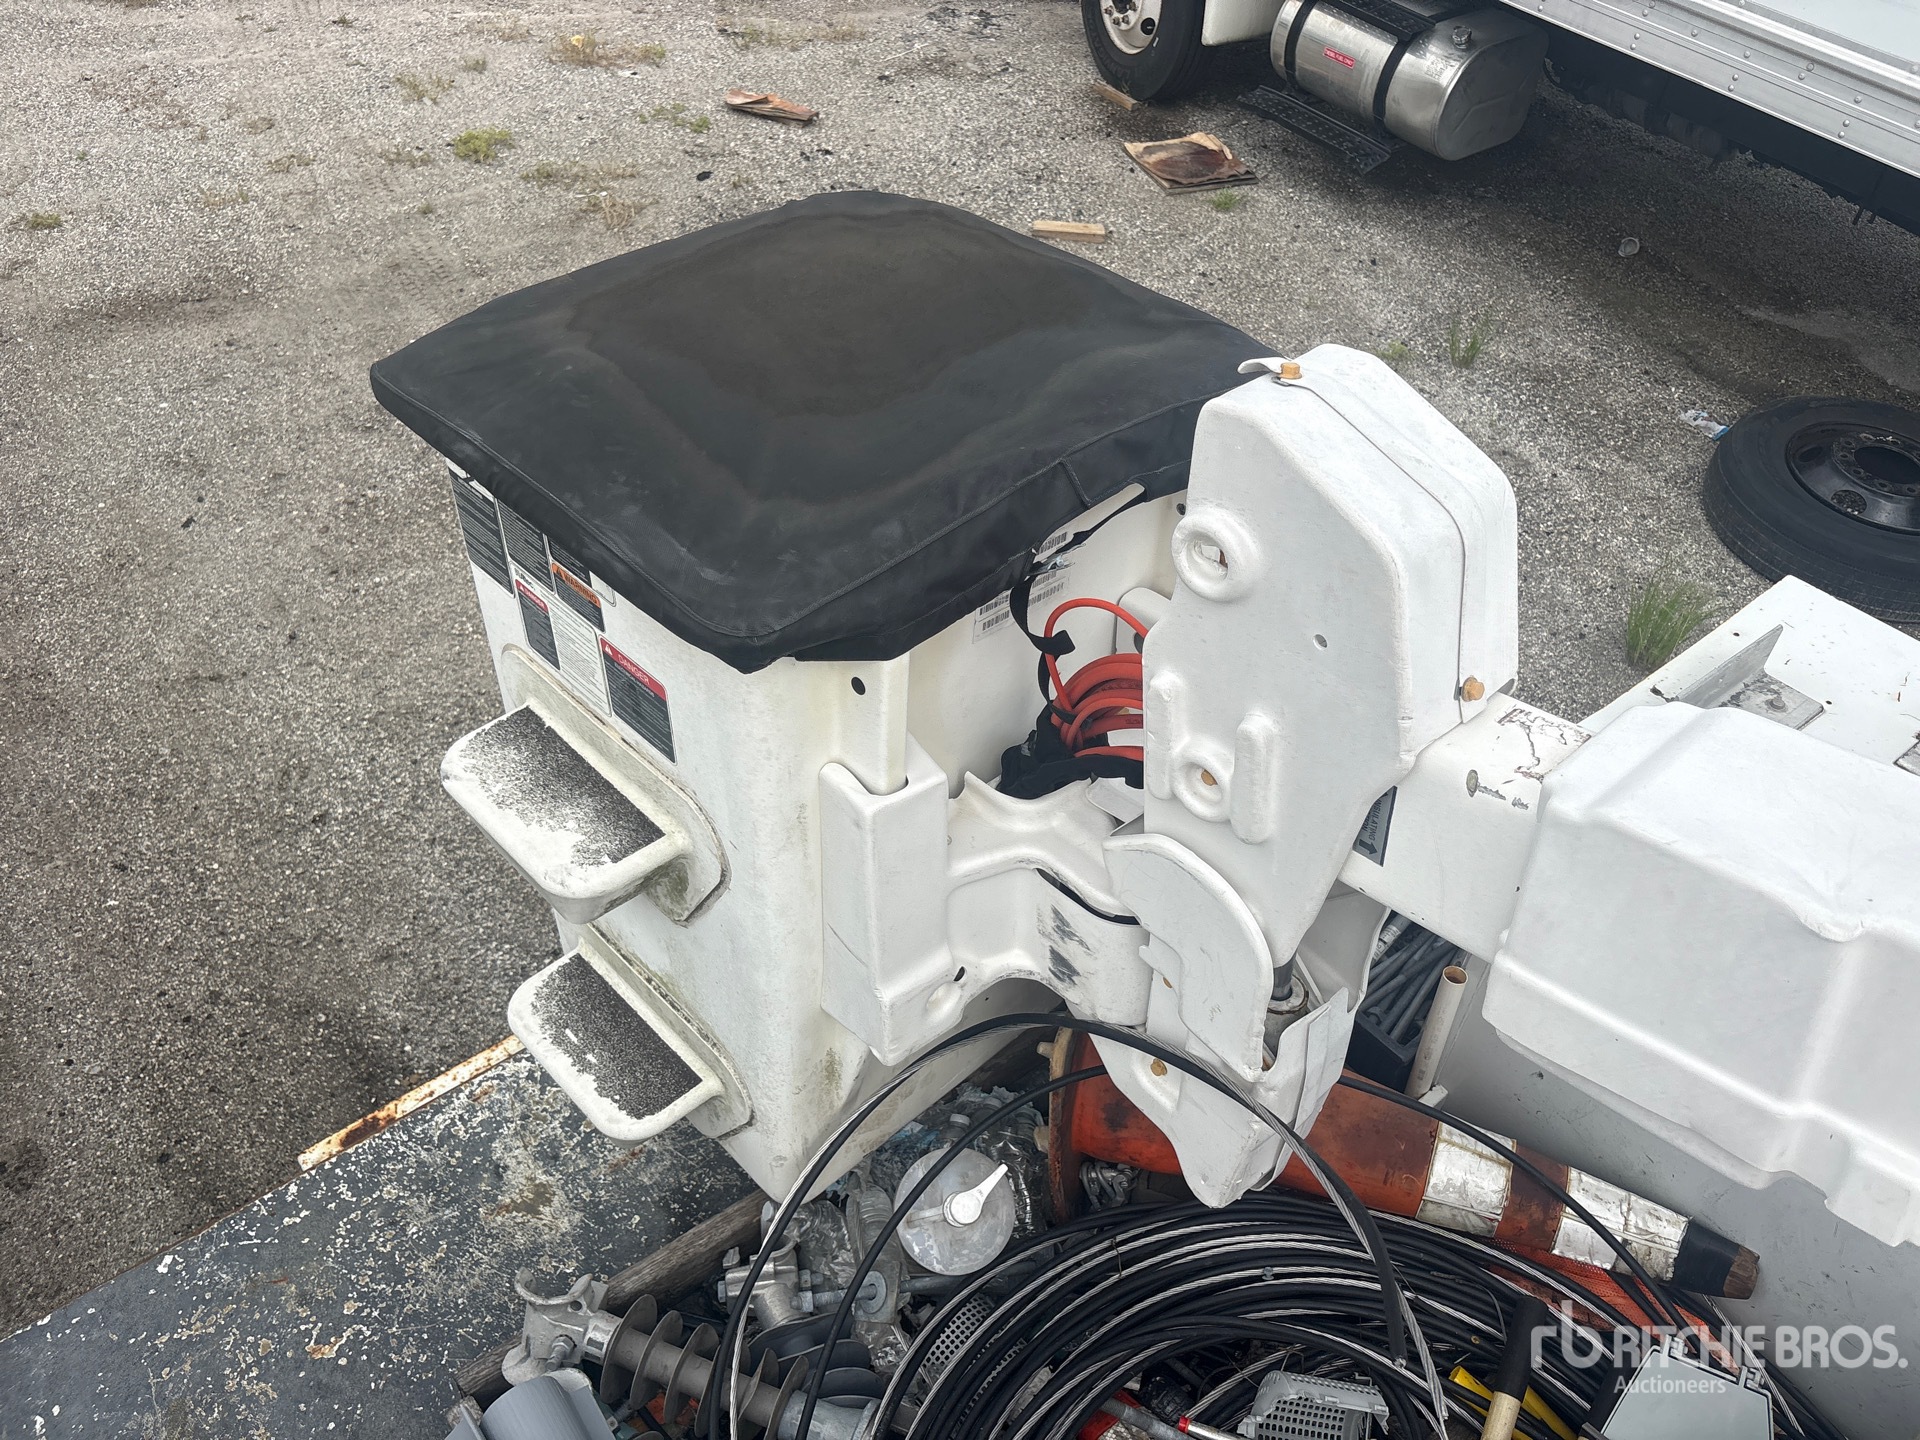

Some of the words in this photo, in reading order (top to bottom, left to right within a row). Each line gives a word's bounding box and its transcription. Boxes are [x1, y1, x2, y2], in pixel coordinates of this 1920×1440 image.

[564, 572, 597, 604] WARNING
[617, 654, 650, 686] DANGER
[1368, 799, 1382, 841] INSULATING
